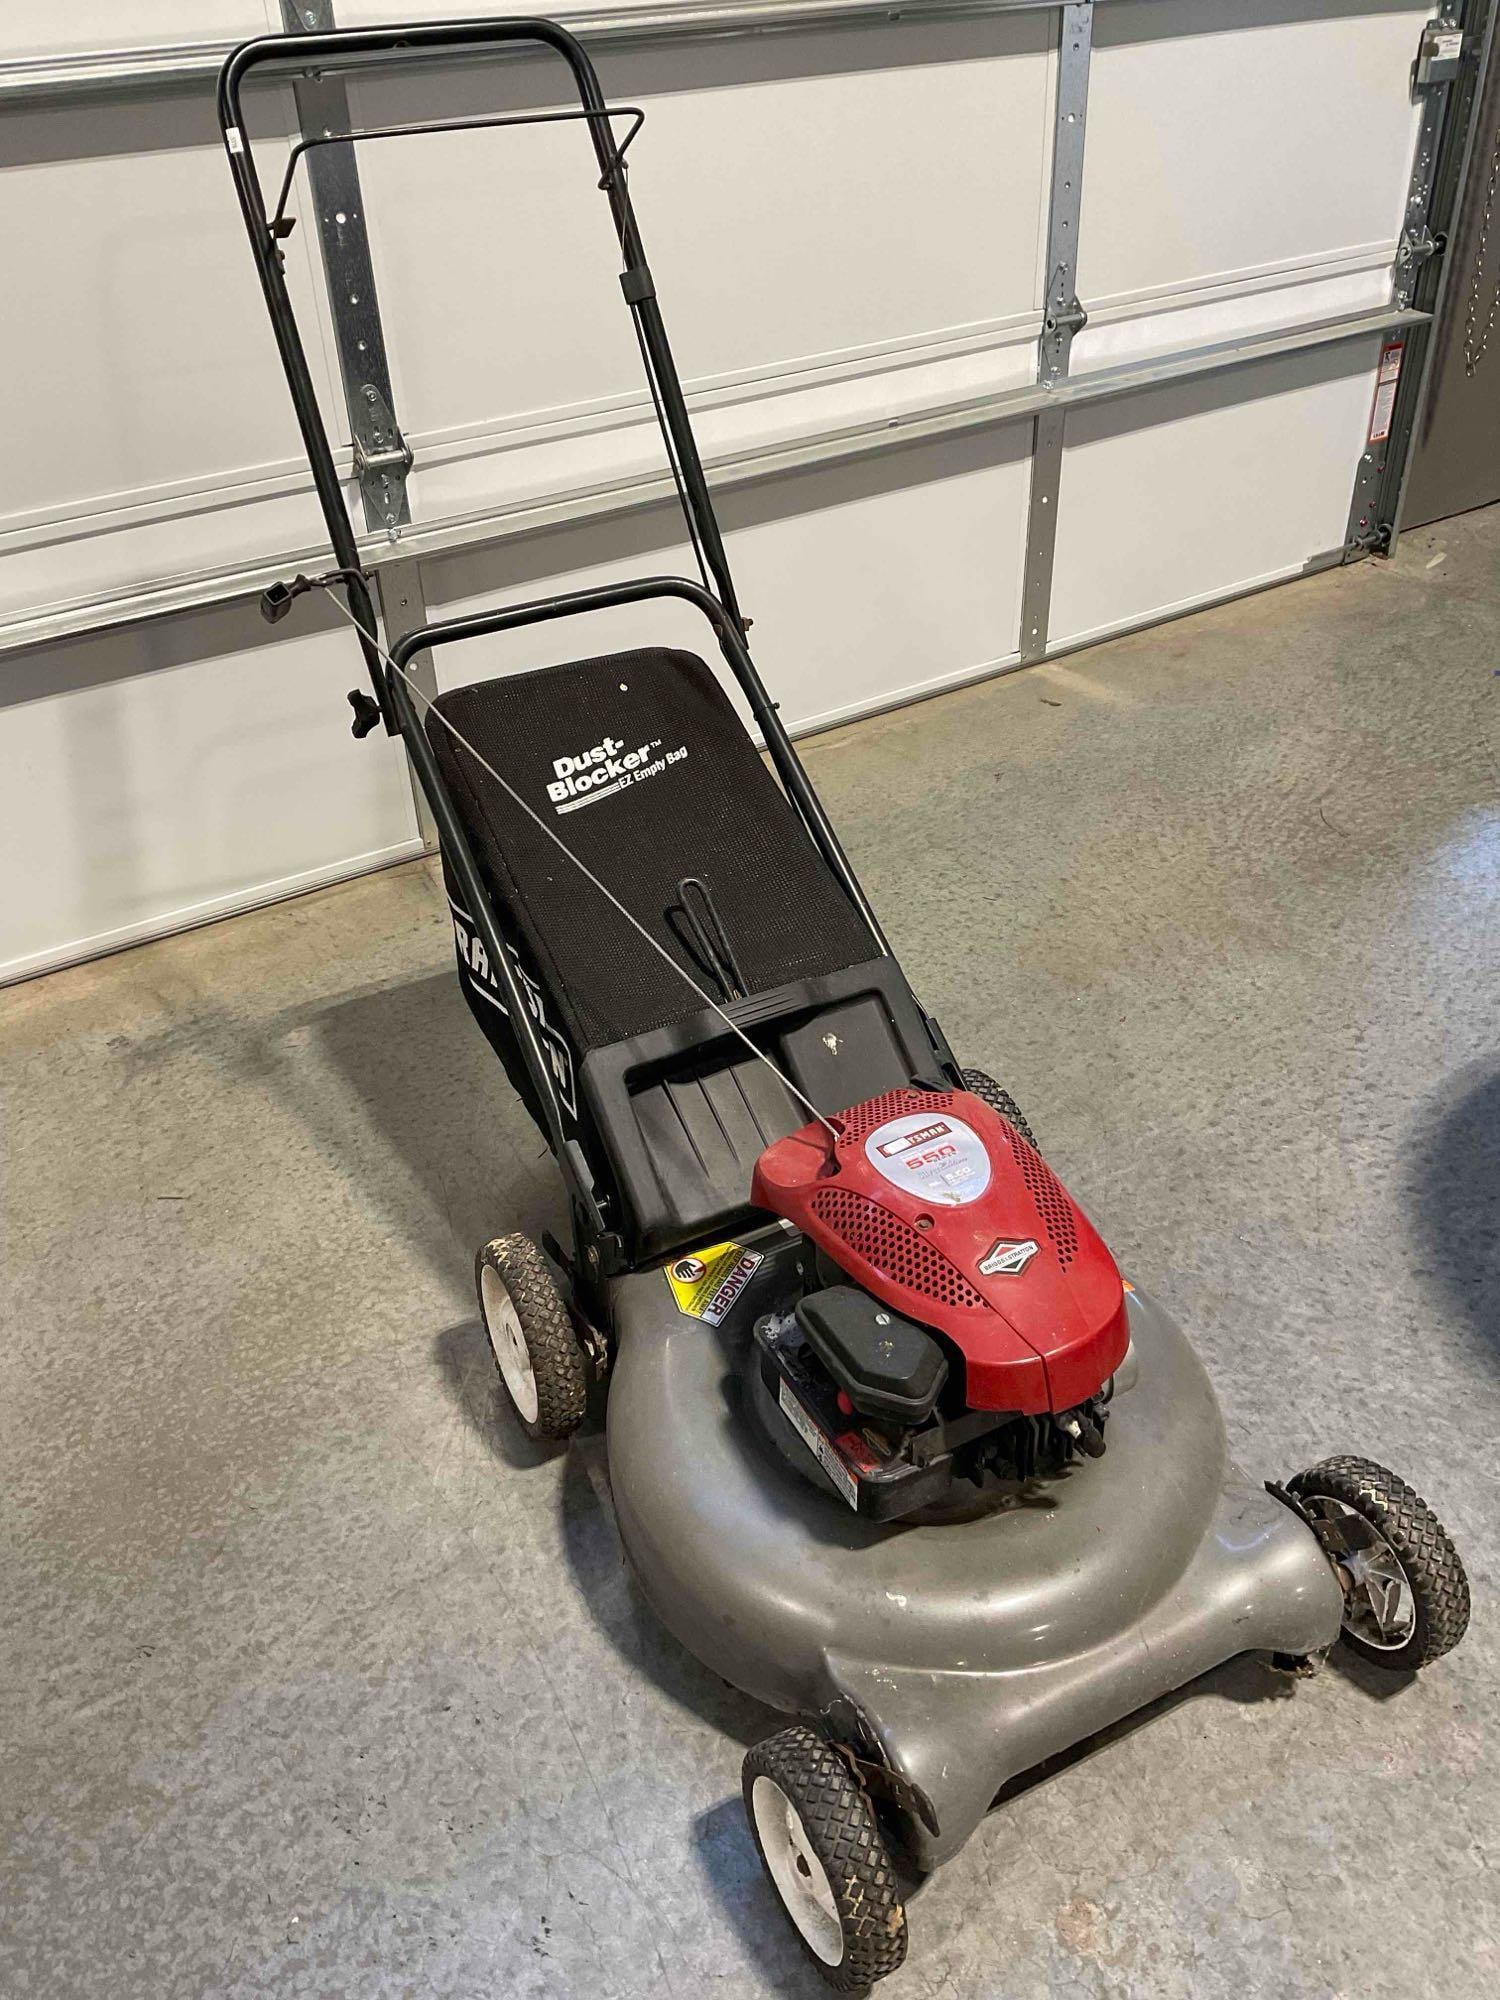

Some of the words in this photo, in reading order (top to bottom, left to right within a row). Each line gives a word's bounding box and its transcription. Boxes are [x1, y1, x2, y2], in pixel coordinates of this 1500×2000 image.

[553, 737, 624, 779] Dust-
[618, 773, 634, 789] EZ
[633, 758, 666, 782] Empty
[665, 745, 689, 765] Bag
[905, 1145, 957, 1170] 550
[708, 1257, 755, 1316] DANGER
